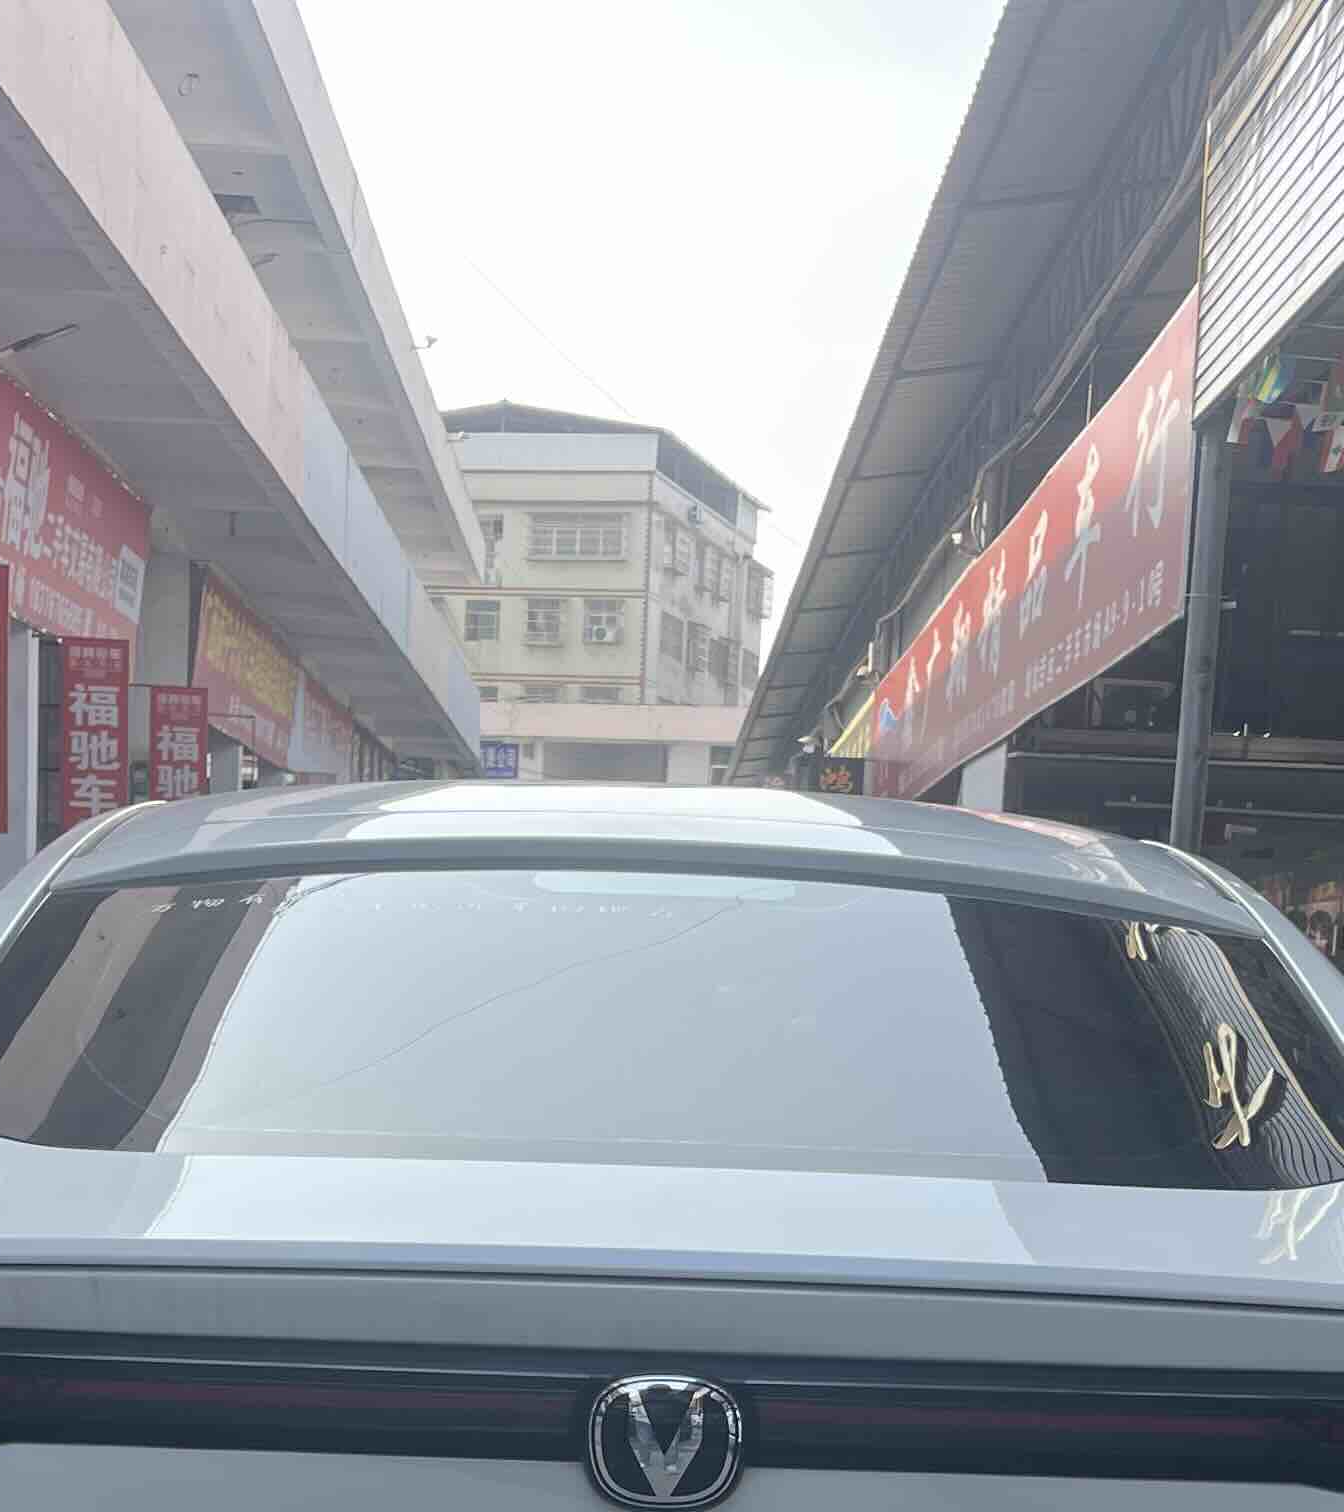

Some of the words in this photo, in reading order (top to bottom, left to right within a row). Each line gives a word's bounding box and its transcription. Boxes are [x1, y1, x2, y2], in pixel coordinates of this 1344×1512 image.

[68, 683, 122, 818] 福驰车
[157, 725, 201, 800] 福驰
